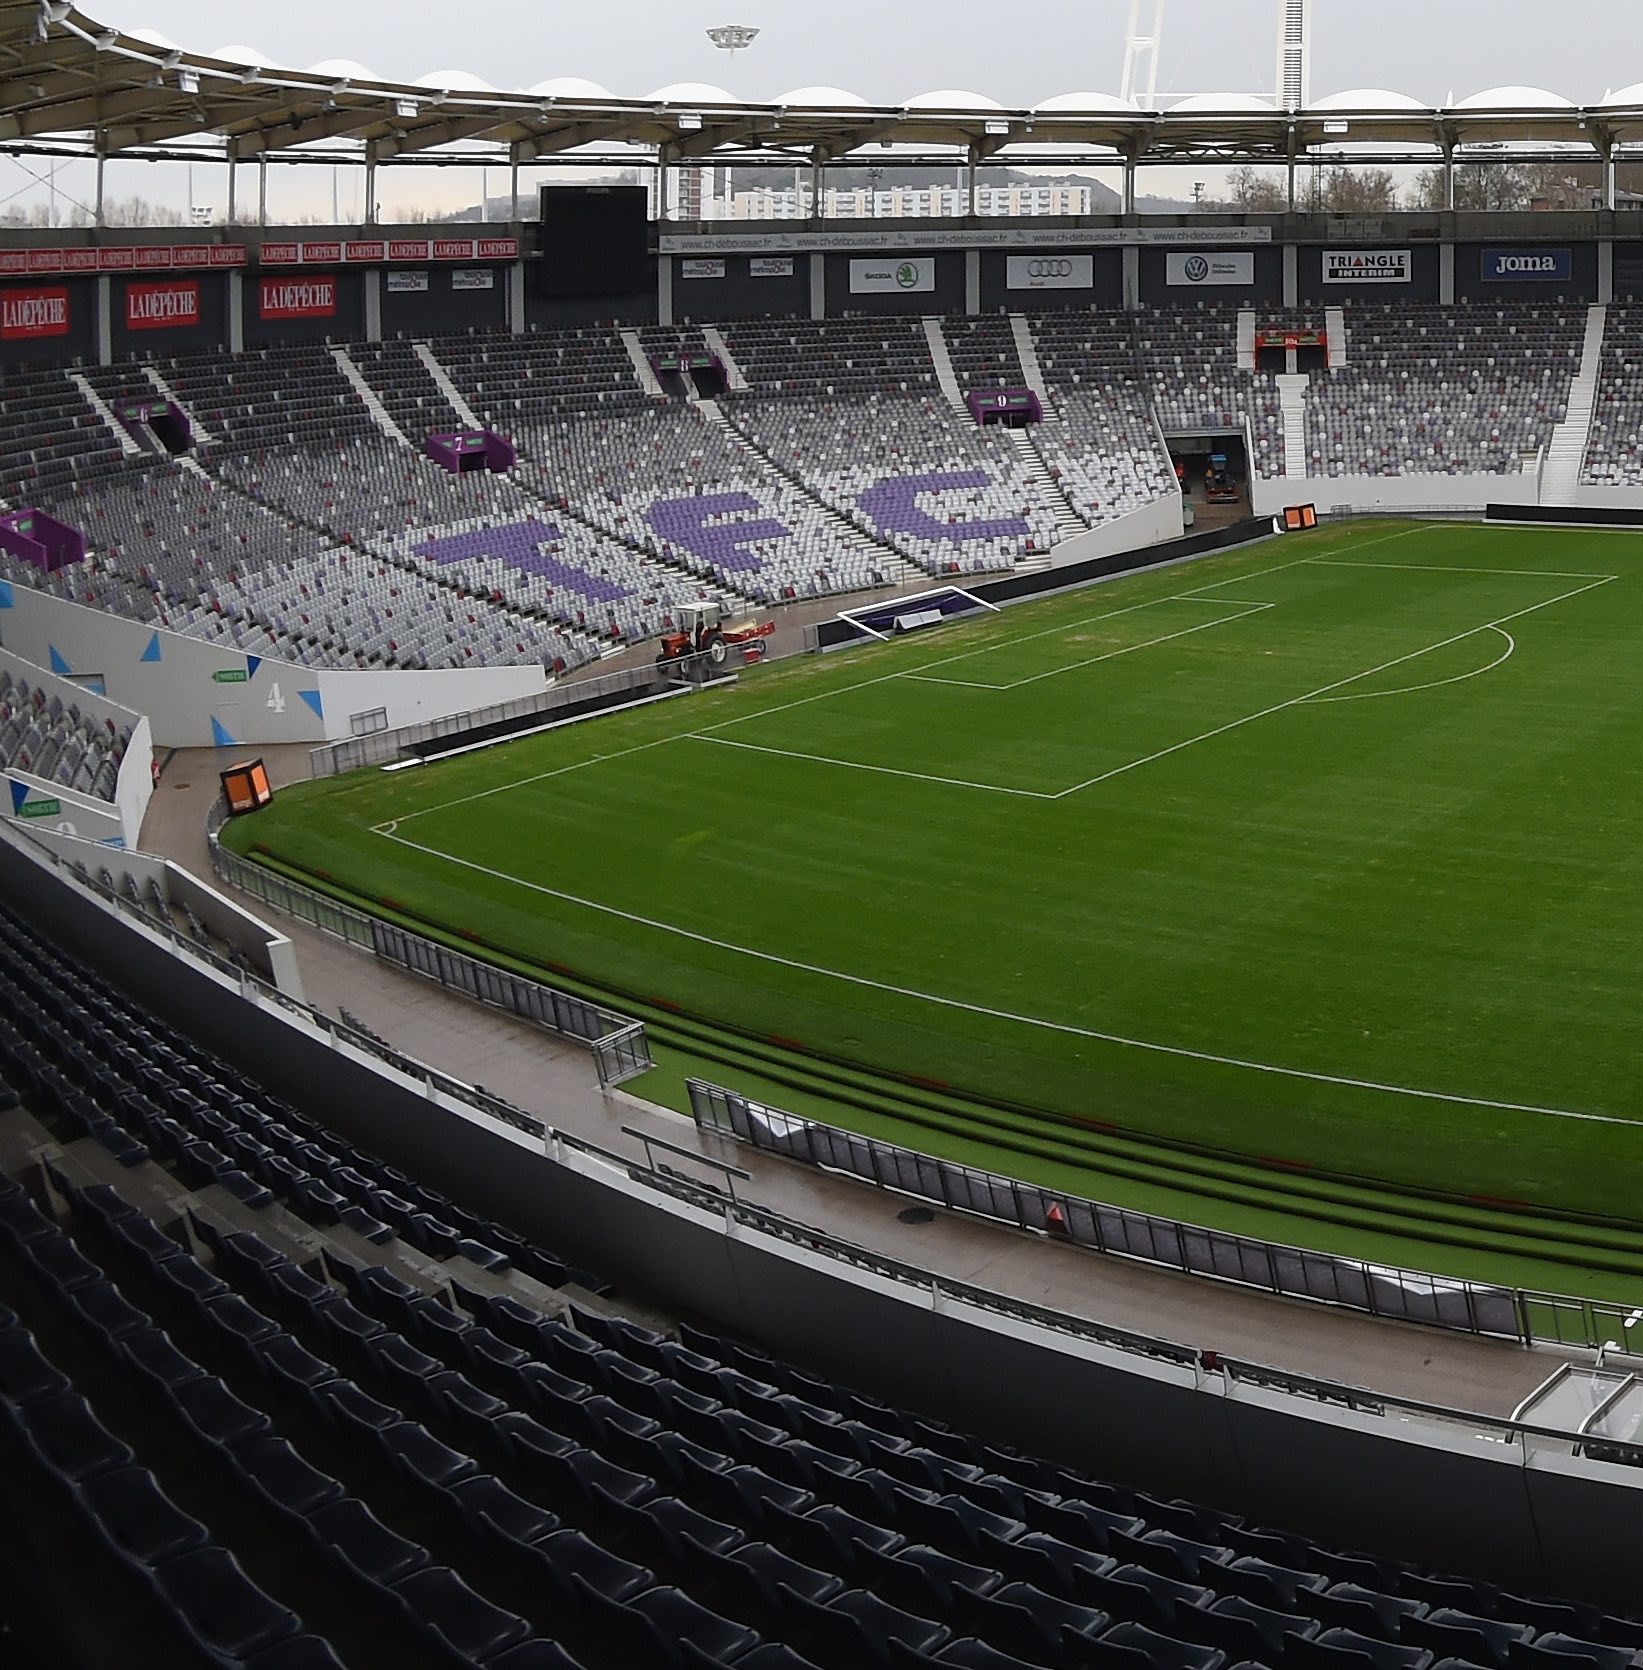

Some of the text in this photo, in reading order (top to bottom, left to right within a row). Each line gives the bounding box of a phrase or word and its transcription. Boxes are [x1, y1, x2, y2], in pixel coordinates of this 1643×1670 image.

[1329, 255, 1405, 267] TRIANGLE
[129, 289, 196, 319] LA DÉPÊCHE
[263, 282, 333, 309] LA DÉPÊCHE
[3, 296, 66, 328] LA DÉPÊCHE
[455, 436, 463, 451] 7
[267, 682, 285, 713] 4
